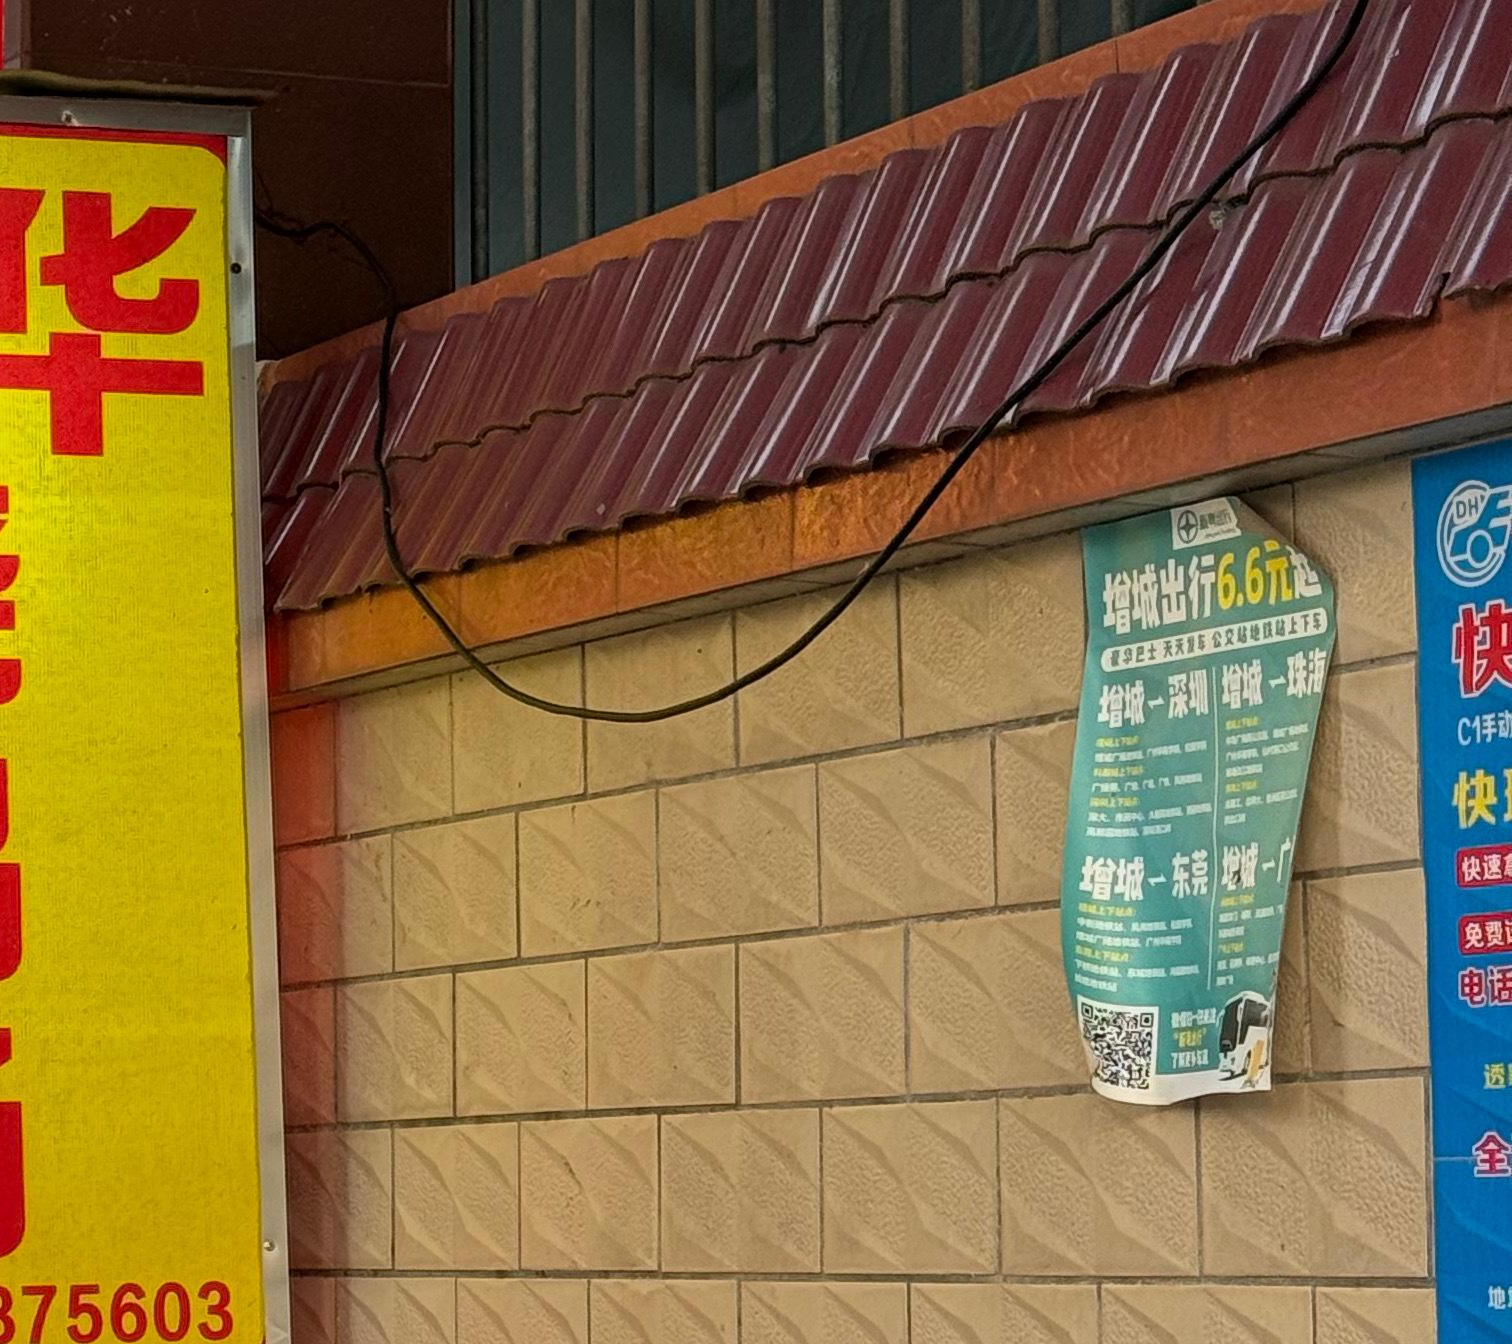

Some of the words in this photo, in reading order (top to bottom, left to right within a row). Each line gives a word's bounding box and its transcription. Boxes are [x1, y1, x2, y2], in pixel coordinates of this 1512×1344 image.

[1455, 494, 1485, 519] DH
[1097, 680, 1145, 729] 增城
[1168, 669, 1208, 720] 深圳
[1221, 659, 1263, 710] 增城
[1452, 767, 1512, 830] 快
[1078, 856, 1145, 902] 增城
[1171, 849, 1209, 899] 东莞
[1483, 1062, 1512, 1089] 透
[1472, 1131, 1512, 1178] 全
[1488, 1285, 1512, 1310] 地
